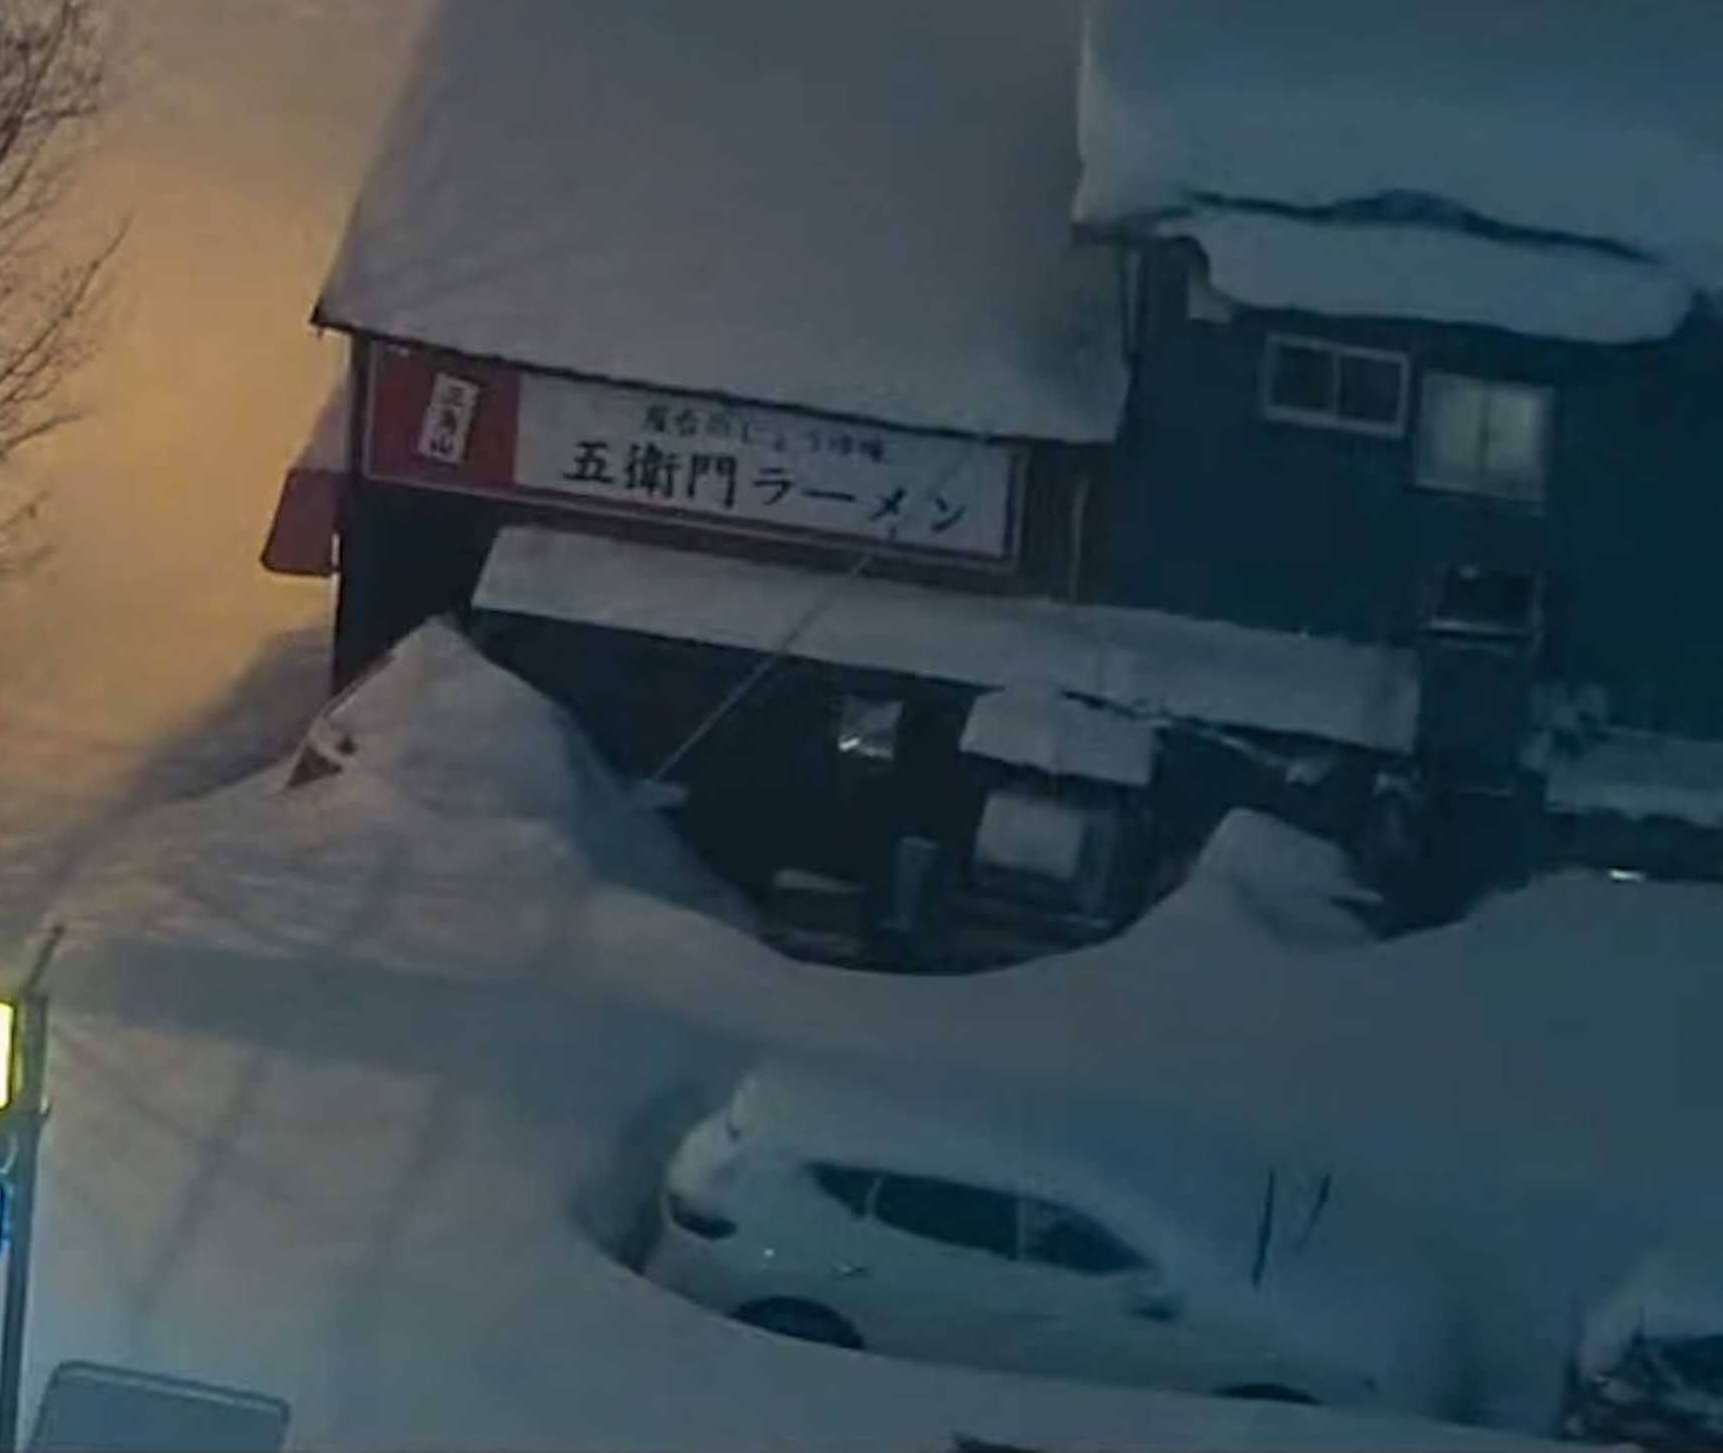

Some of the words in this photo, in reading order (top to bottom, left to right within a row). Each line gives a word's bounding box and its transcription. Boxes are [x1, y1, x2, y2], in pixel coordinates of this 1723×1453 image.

[562, 438, 968, 533] 五衛門ラーメン
